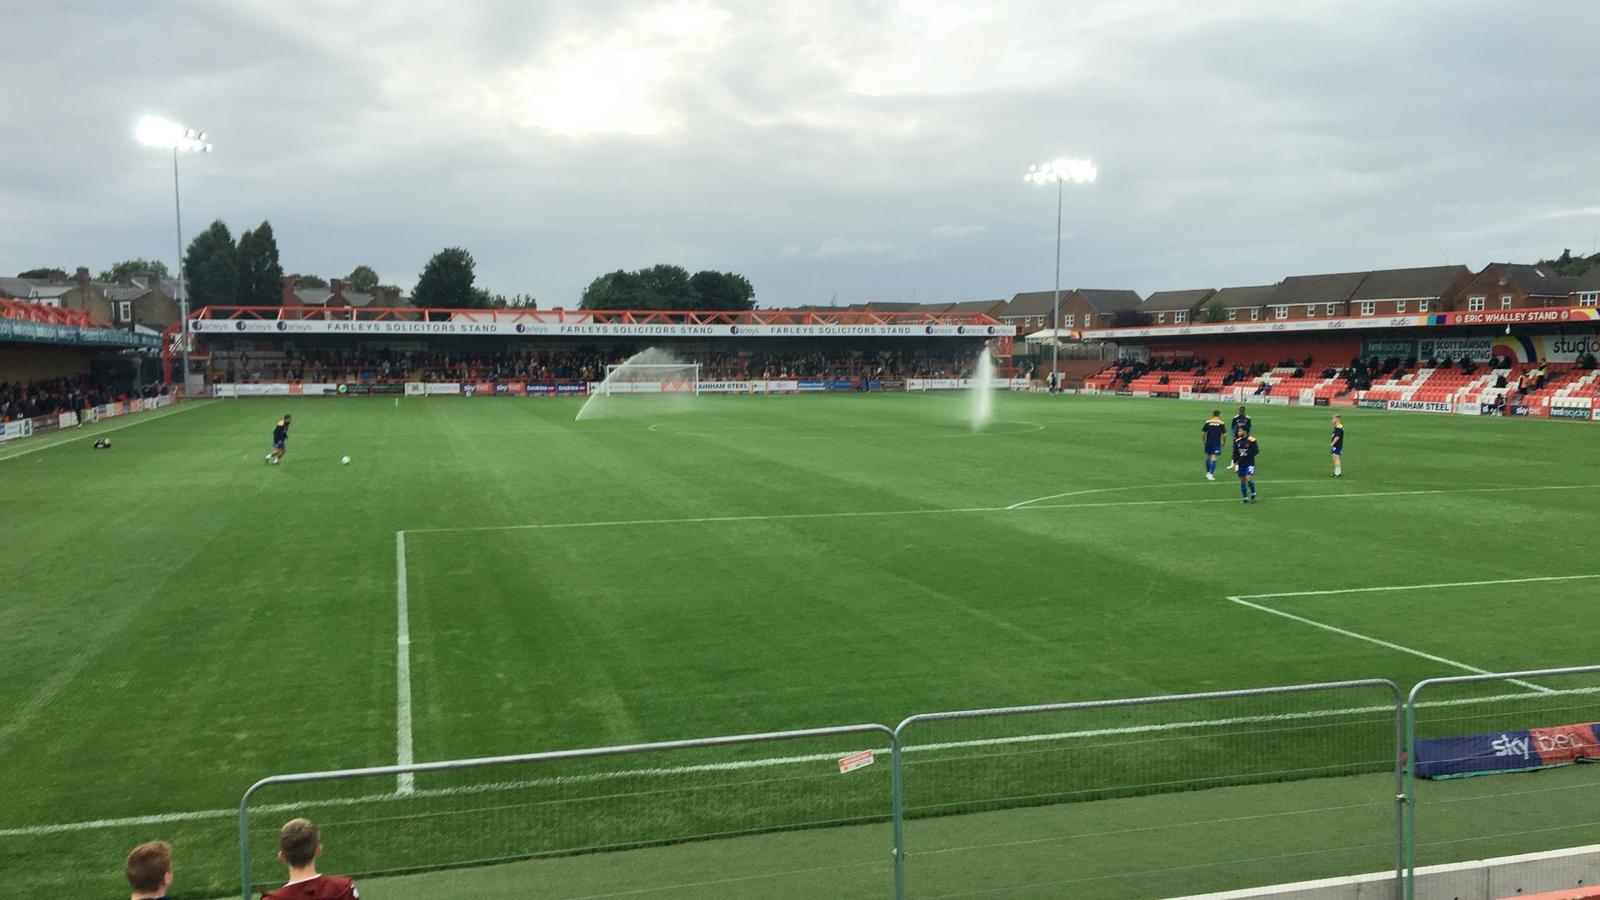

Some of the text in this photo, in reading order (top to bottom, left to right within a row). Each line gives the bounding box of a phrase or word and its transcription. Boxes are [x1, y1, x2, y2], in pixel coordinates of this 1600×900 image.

[1464, 311, 1558, 323] ERIC WHALLEY STAND
[328, 323, 497, 332] FARLEYS SOLICITORS STAND
[560, 326, 713, 334] FARLEYS SOLICITORS STAND
[1436, 340, 1457, 350] SCOTT
[1553, 335, 1600, 354] studio
[1436, 349, 1491, 360] ADVERTISING
[464, 383, 475, 392] sky
[477, 383, 489, 391] bet
[496, 383, 508, 391] sky
[1390, 401, 1449, 411] RAINHAM STEEL
[1516, 407, 1529, 416] sky
[1491, 730, 1584, 760] sky bet
